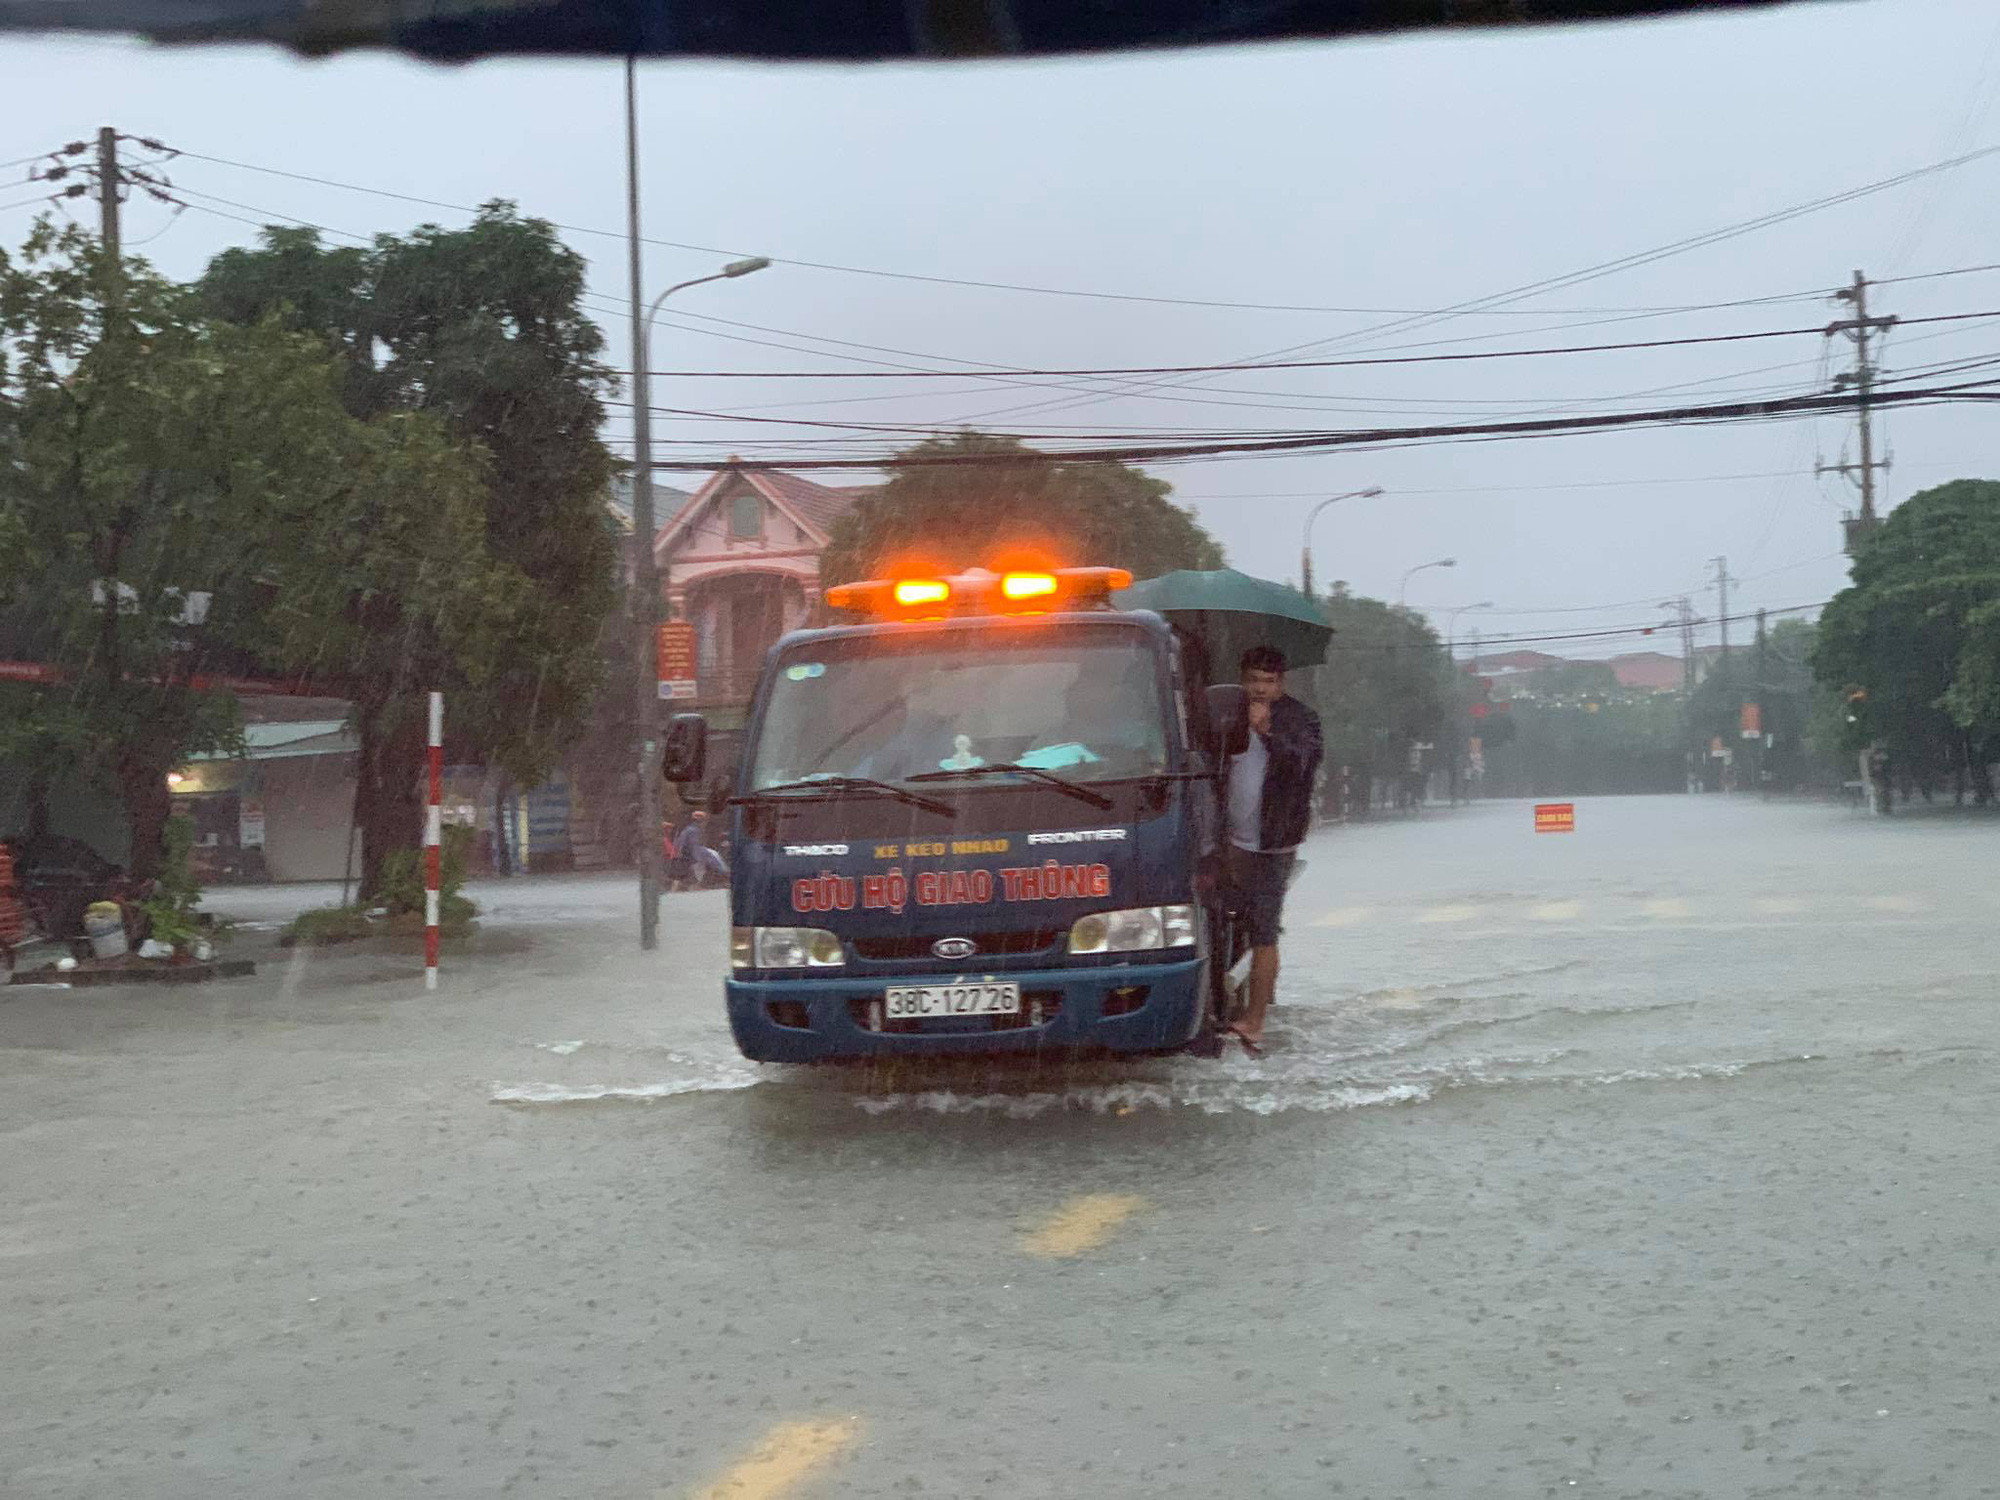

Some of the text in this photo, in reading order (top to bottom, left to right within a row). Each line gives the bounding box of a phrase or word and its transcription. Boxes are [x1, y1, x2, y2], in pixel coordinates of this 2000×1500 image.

[1027, 829, 1128, 845] FRONTIER
[863, 867, 907, 914] HỘ
[916, 868, 992, 906] GIAO
[1000, 859, 1110, 901] THÔNG
